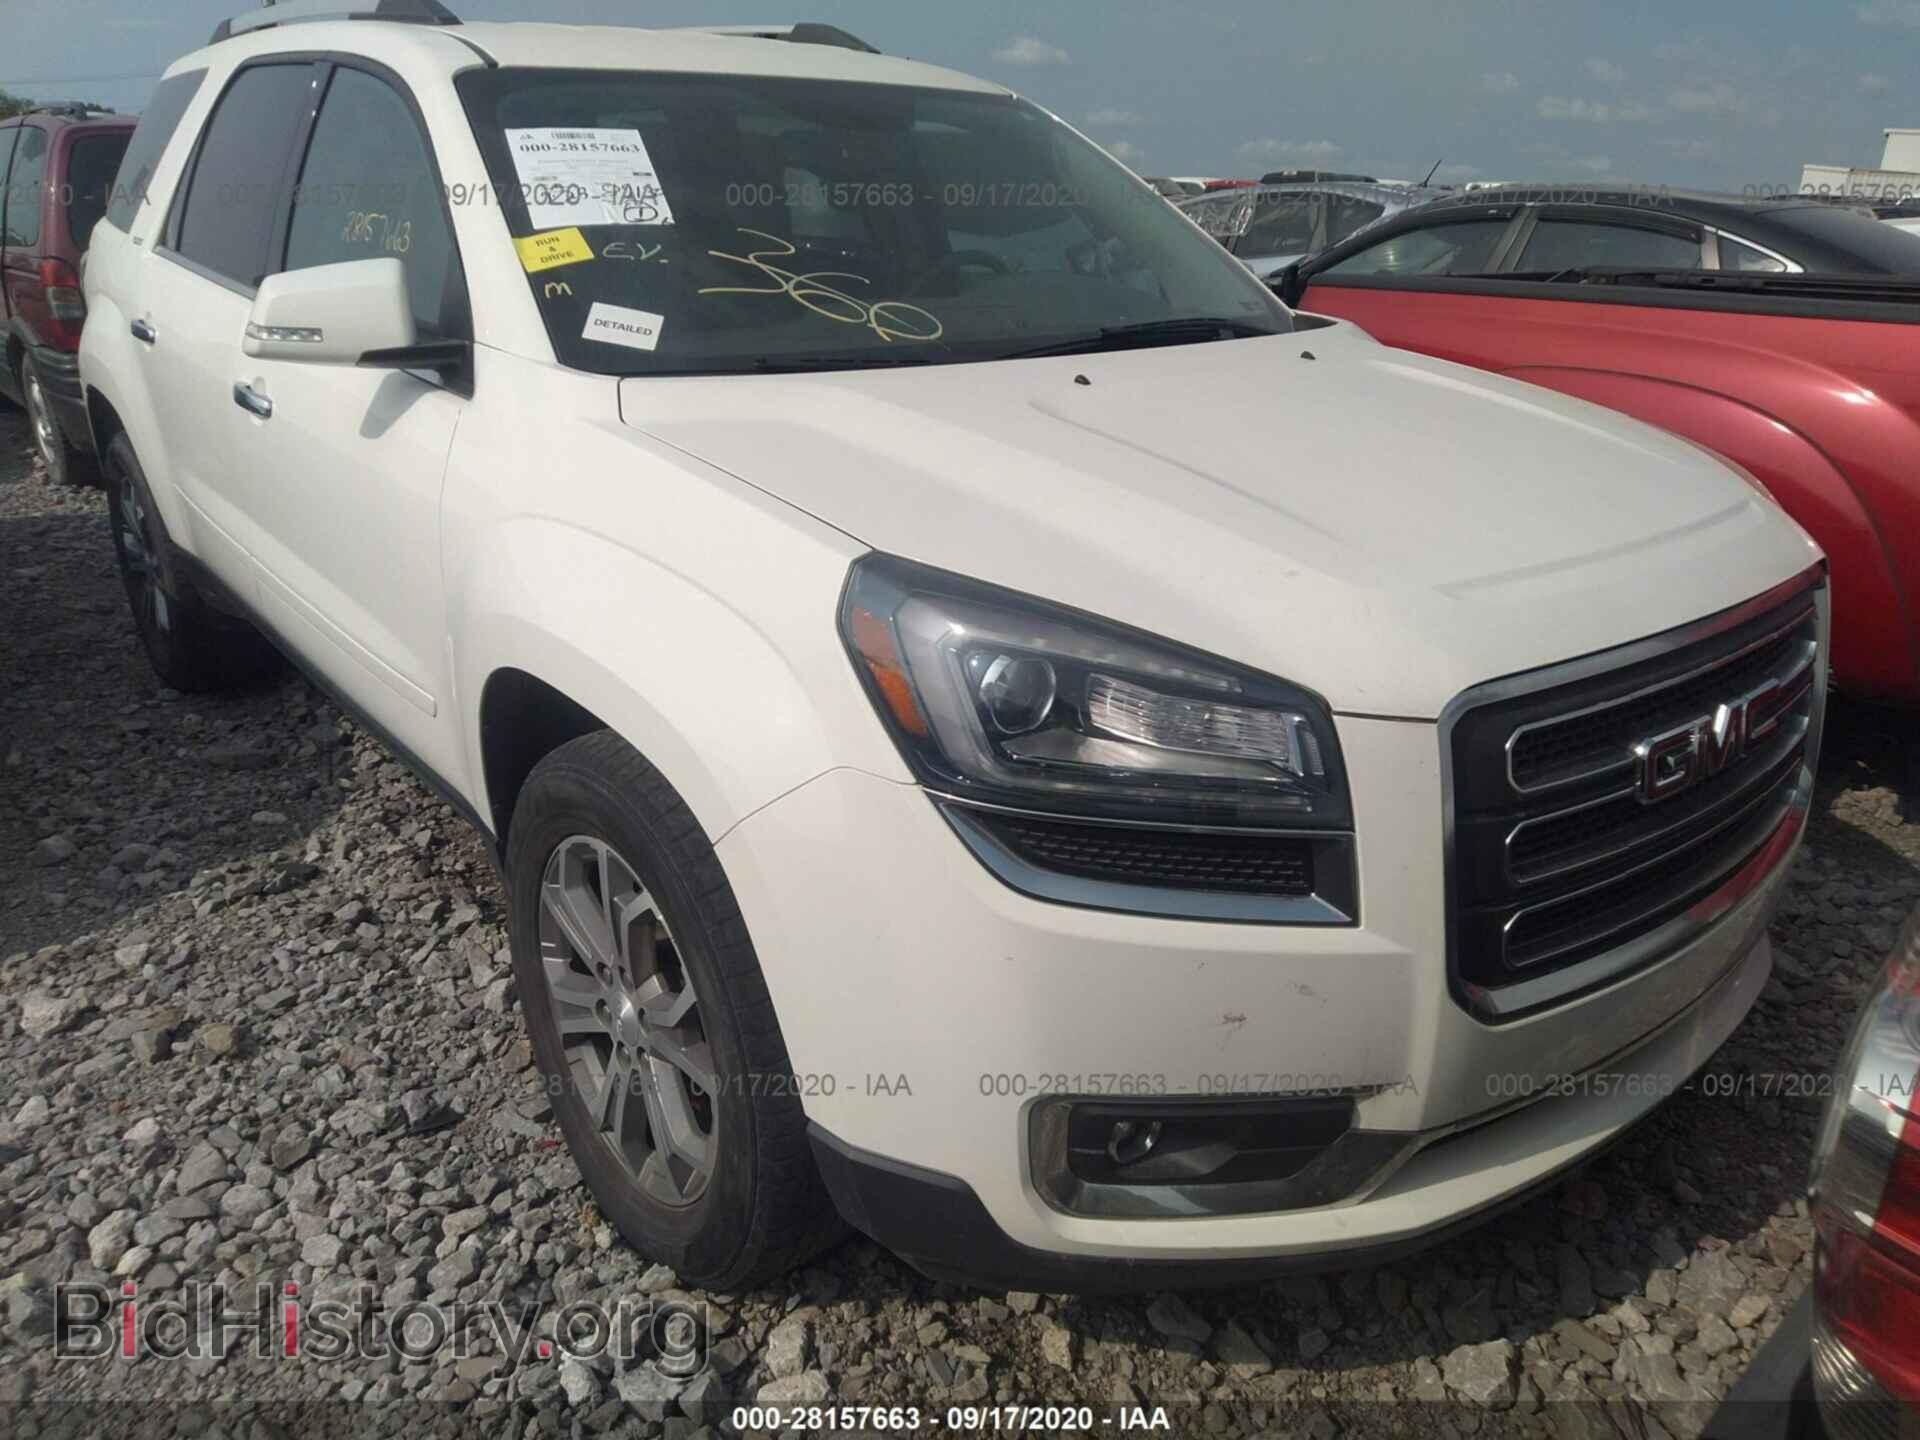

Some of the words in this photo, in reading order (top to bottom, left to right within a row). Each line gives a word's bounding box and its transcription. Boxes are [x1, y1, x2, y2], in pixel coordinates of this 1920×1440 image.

[519, 143, 641, 153] 000-28157663
[535, 236, 561, 247] RUN
[540, 251, 575, 263] DRIVE
[593, 318, 654, 336] DETAILED
[1634, 677, 1781, 806] GMC
